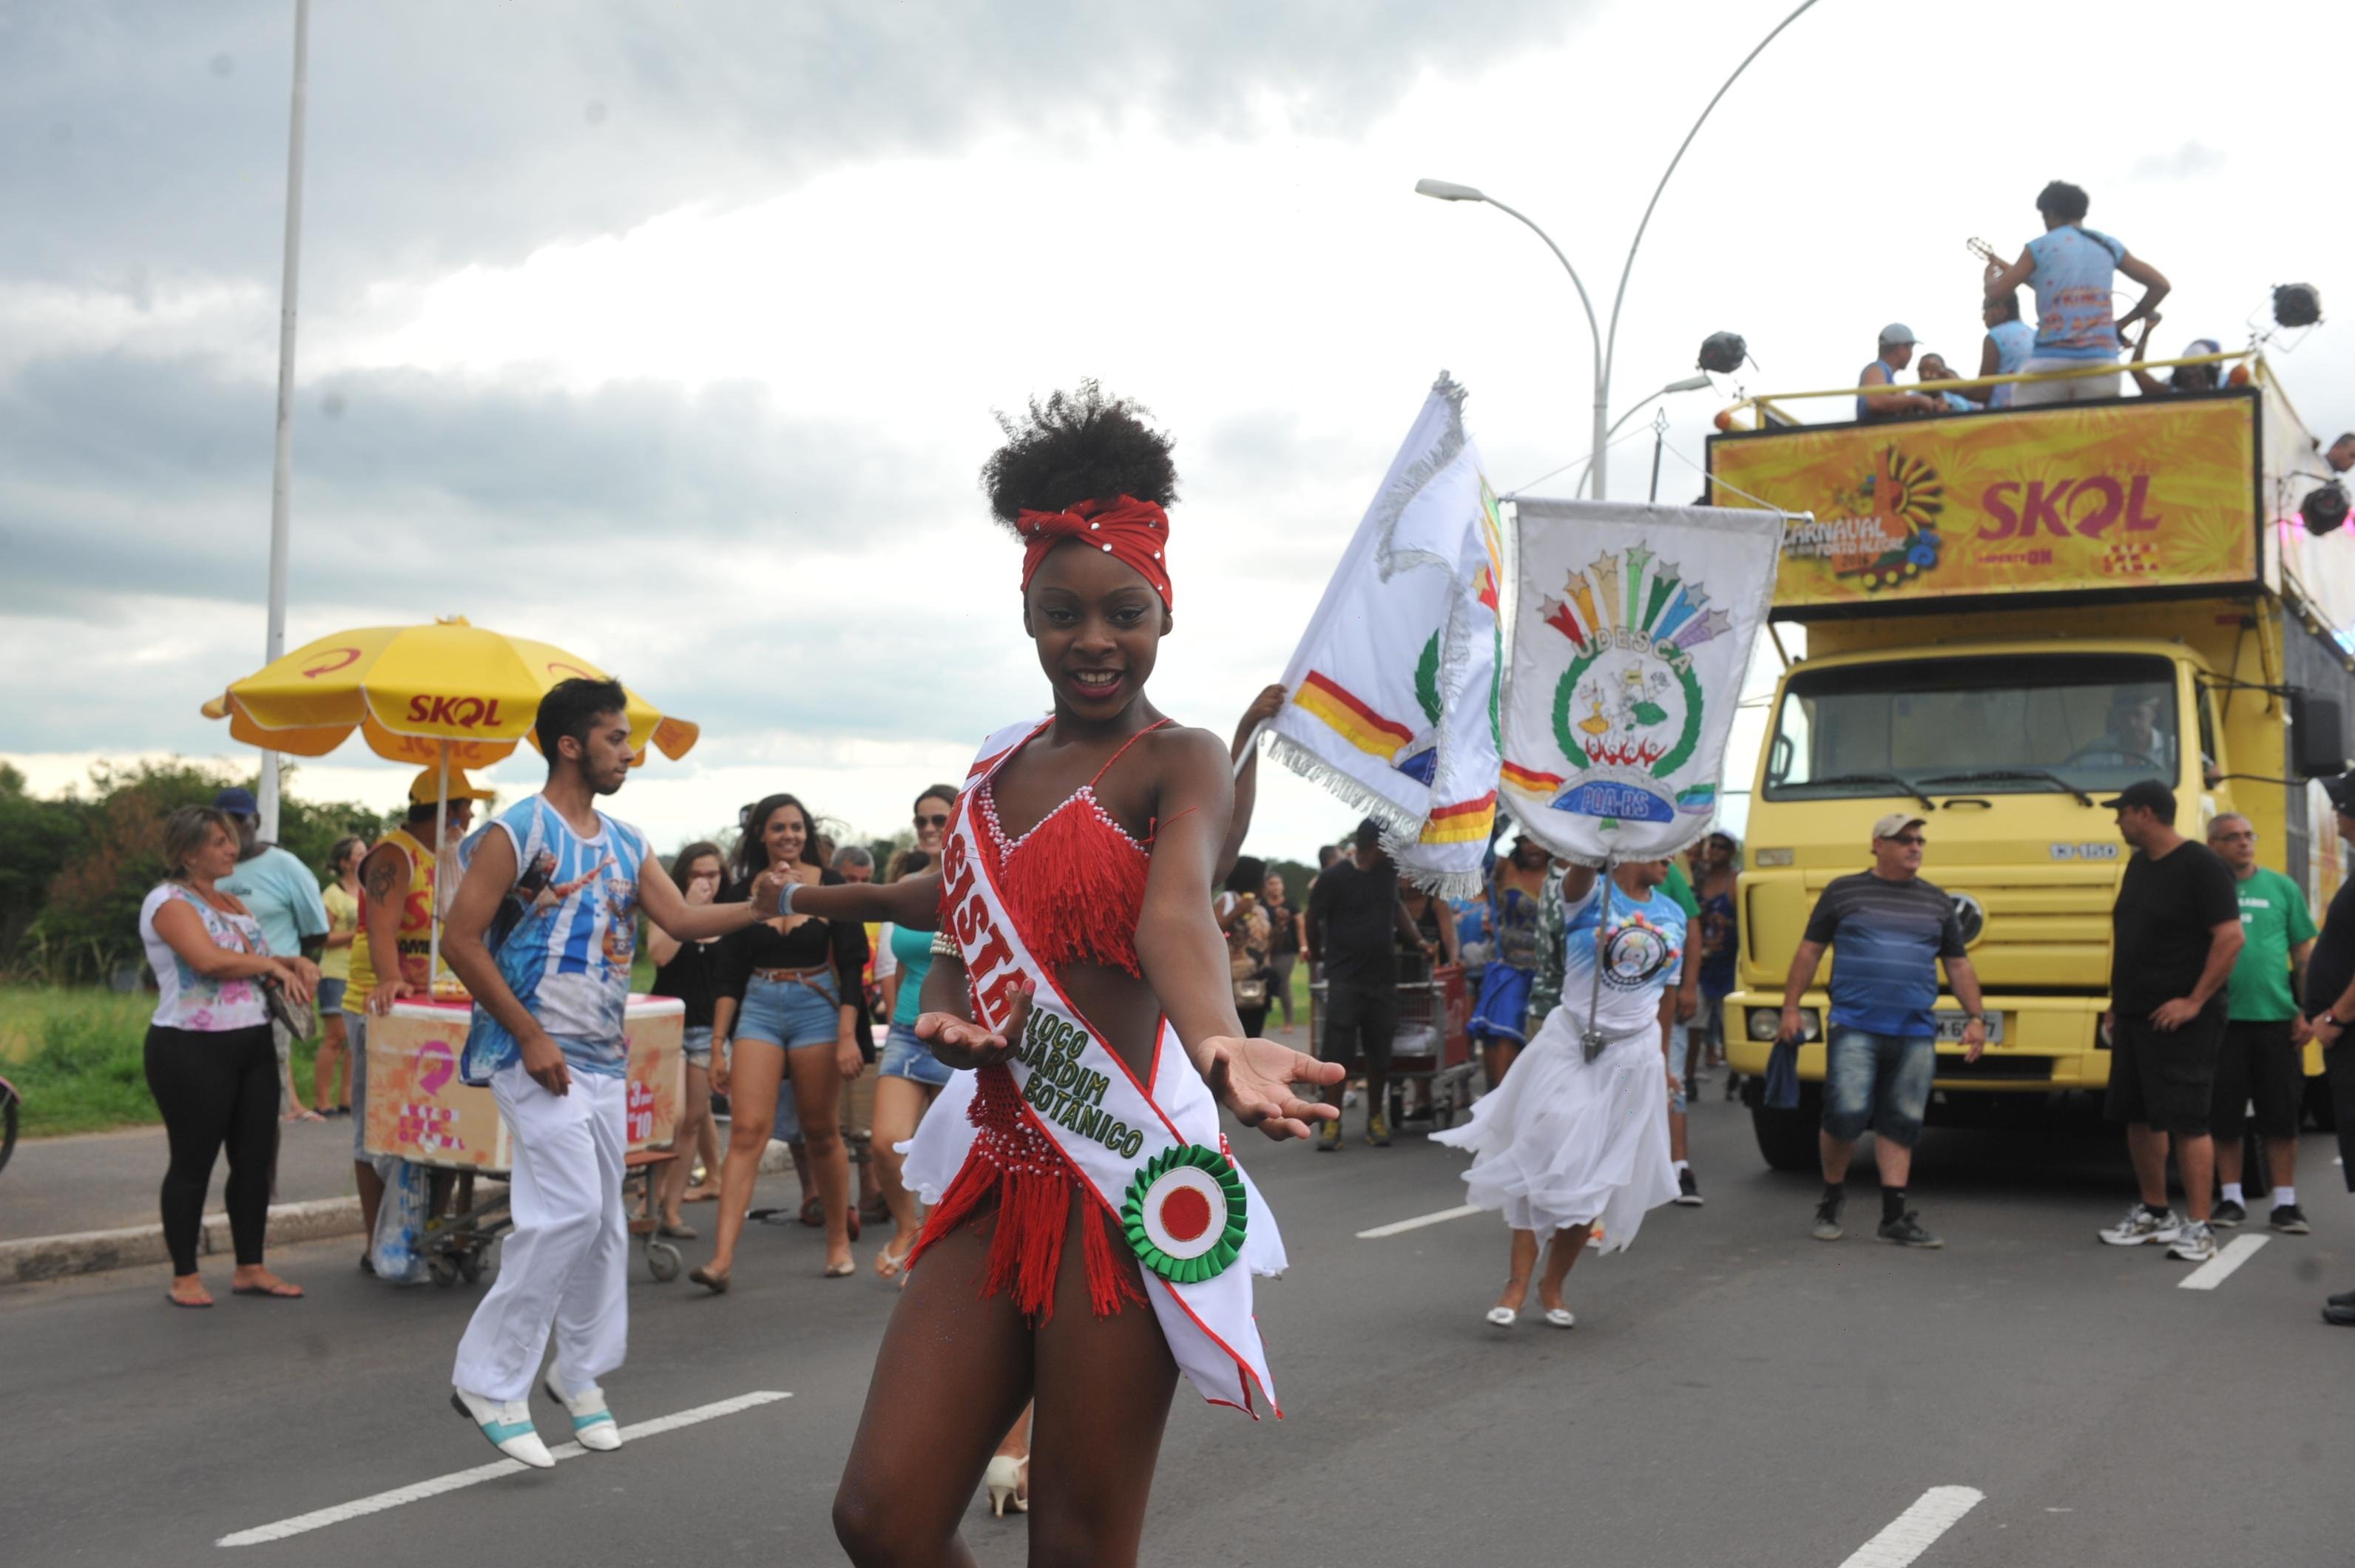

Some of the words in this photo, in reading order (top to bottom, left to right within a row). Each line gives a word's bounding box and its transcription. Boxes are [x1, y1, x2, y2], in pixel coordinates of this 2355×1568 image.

[1977, 475, 2163, 541] SKOL
[1571, 626, 1694, 675] UDESCA
[407, 695, 502, 729] SKOL
[1581, 785, 1649, 818] POA-RS
[1017, 1033, 1110, 1106] JARDIM
[1021, 1072, 1143, 1160] BOTÂNICO
